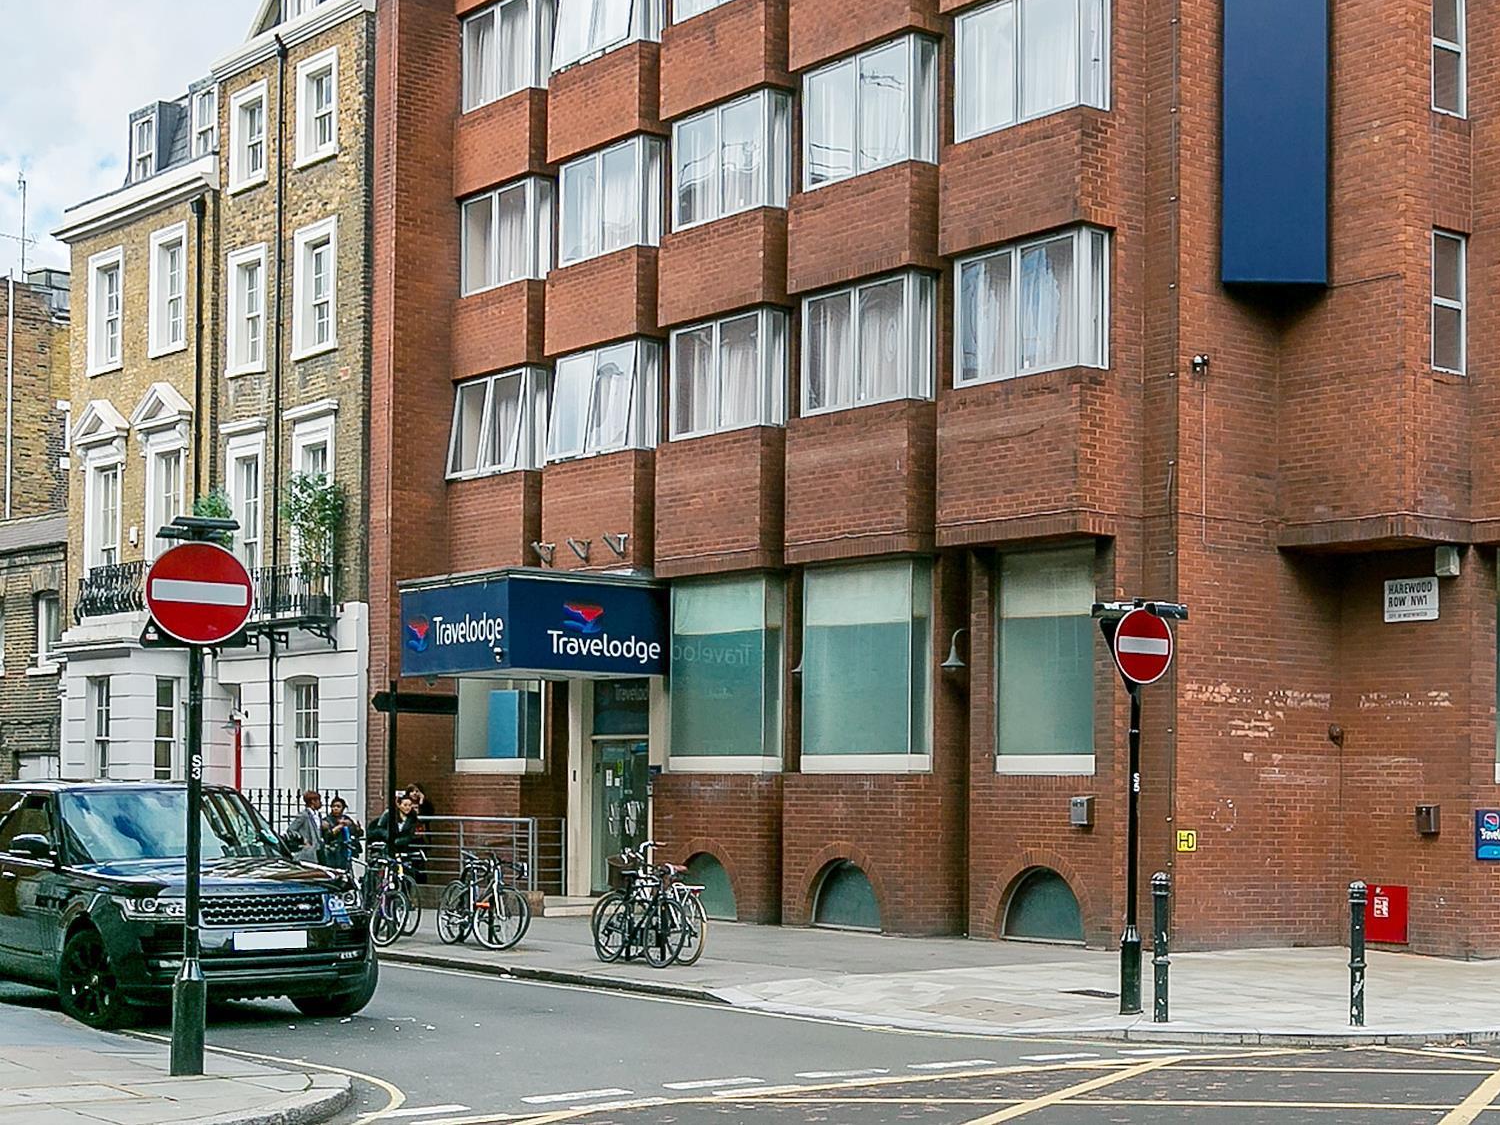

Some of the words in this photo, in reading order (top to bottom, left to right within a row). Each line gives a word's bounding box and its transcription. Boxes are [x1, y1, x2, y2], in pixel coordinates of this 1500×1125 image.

[1388, 581, 1432, 594] HAREWOOD
[1388, 596, 1406, 607] ROW
[1410, 595, 1427, 606] NW1
[432, 612, 503, 647] Travelodge
[547, 629, 661, 664] Travelodge
